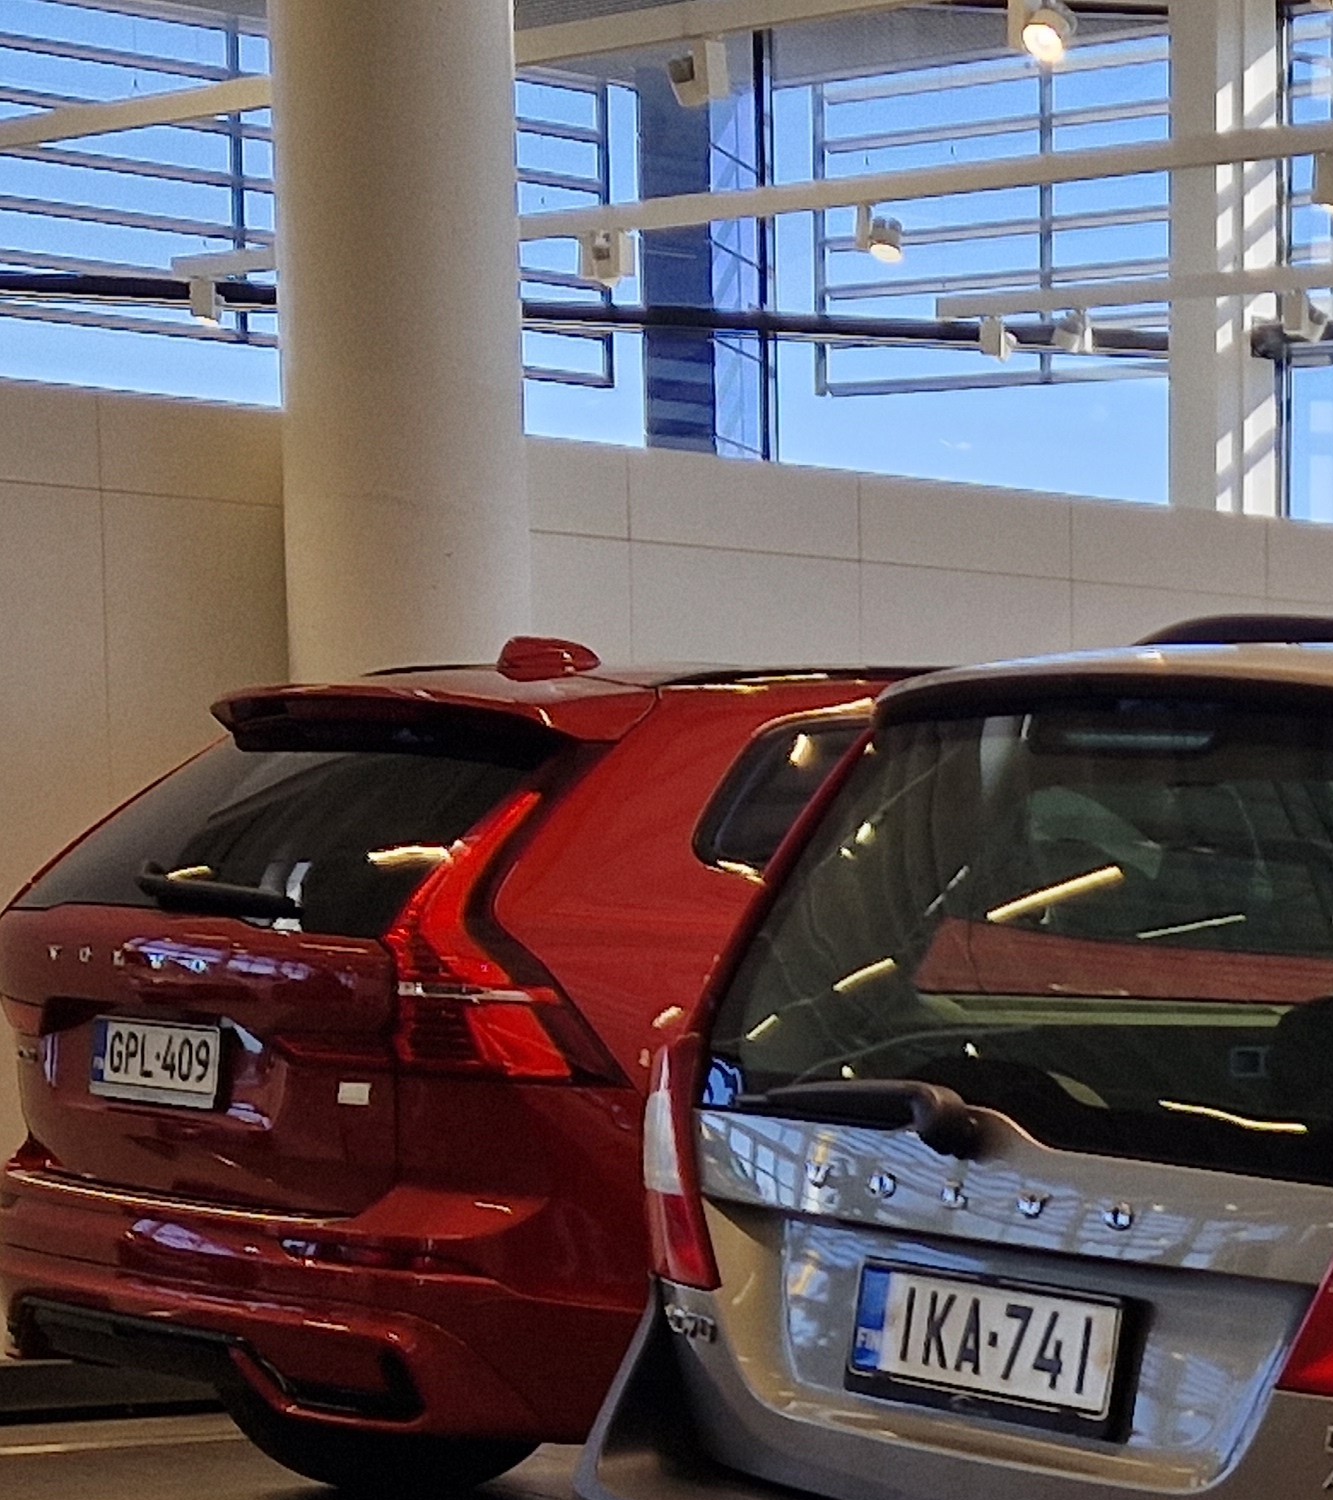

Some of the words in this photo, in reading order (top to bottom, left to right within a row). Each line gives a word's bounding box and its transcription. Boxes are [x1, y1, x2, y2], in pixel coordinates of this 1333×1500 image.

[109, 1030, 211, 1083] GPL-409
[804, 1160, 1137, 1232] VOLVO
[899, 1286, 1093, 1396] IKA-741
